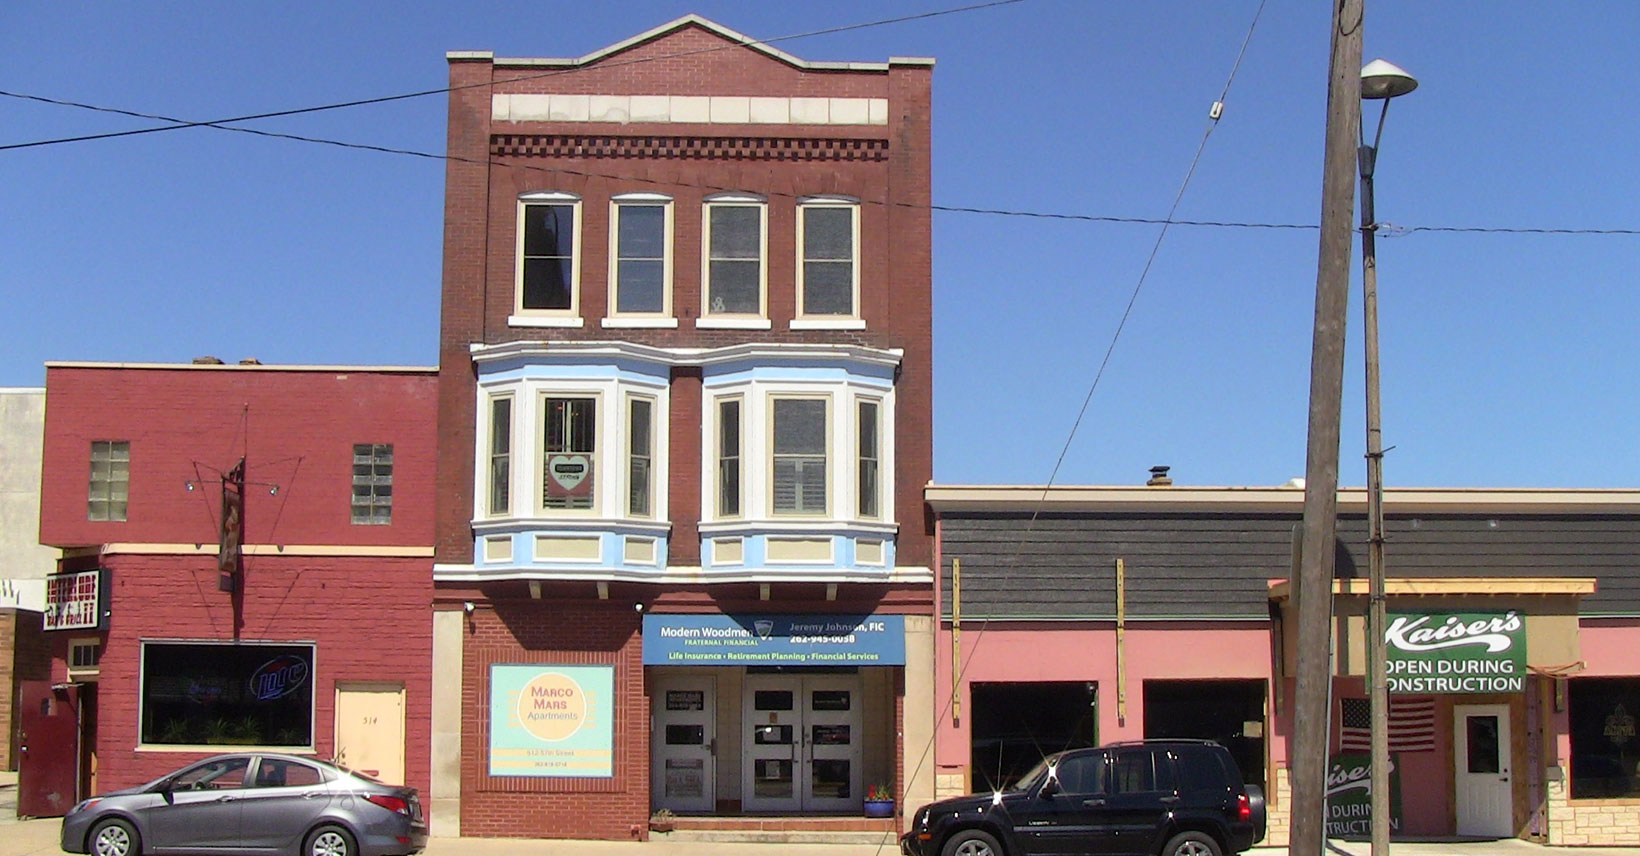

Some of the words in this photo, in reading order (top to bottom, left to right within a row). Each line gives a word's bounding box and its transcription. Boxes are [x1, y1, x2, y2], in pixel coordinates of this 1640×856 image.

[47, 574, 96, 604] INTERLUDE
[661, 627, 700, 637] Modern
[702, 627, 754, 637] Woodmen
[790, 622, 824, 633] Jeremy
[825, 622, 868, 632] Johnson,
[869, 622, 885, 632] FIC
[1385, 611, 1521, 652] Kaiser's
[668, 652, 683, 660] Life
[684, 652, 722, 660] Insurance
[727, 652, 770, 660] Retirement
[771, 652, 806, 662] Planning
[811, 652, 846, 661] Financial
[847, 652, 879, 661] Services
[1438, 660, 1513, 674] DURING
[1386, 677, 1522, 691] ONSTRUCTION
[531, 686, 573, 698] MARCO
[533, 699, 568, 710] MARS
[363, 717, 378, 725] 514
[527, 711, 578, 722] Apartments
[1332, 803, 1373, 818] DURIN
